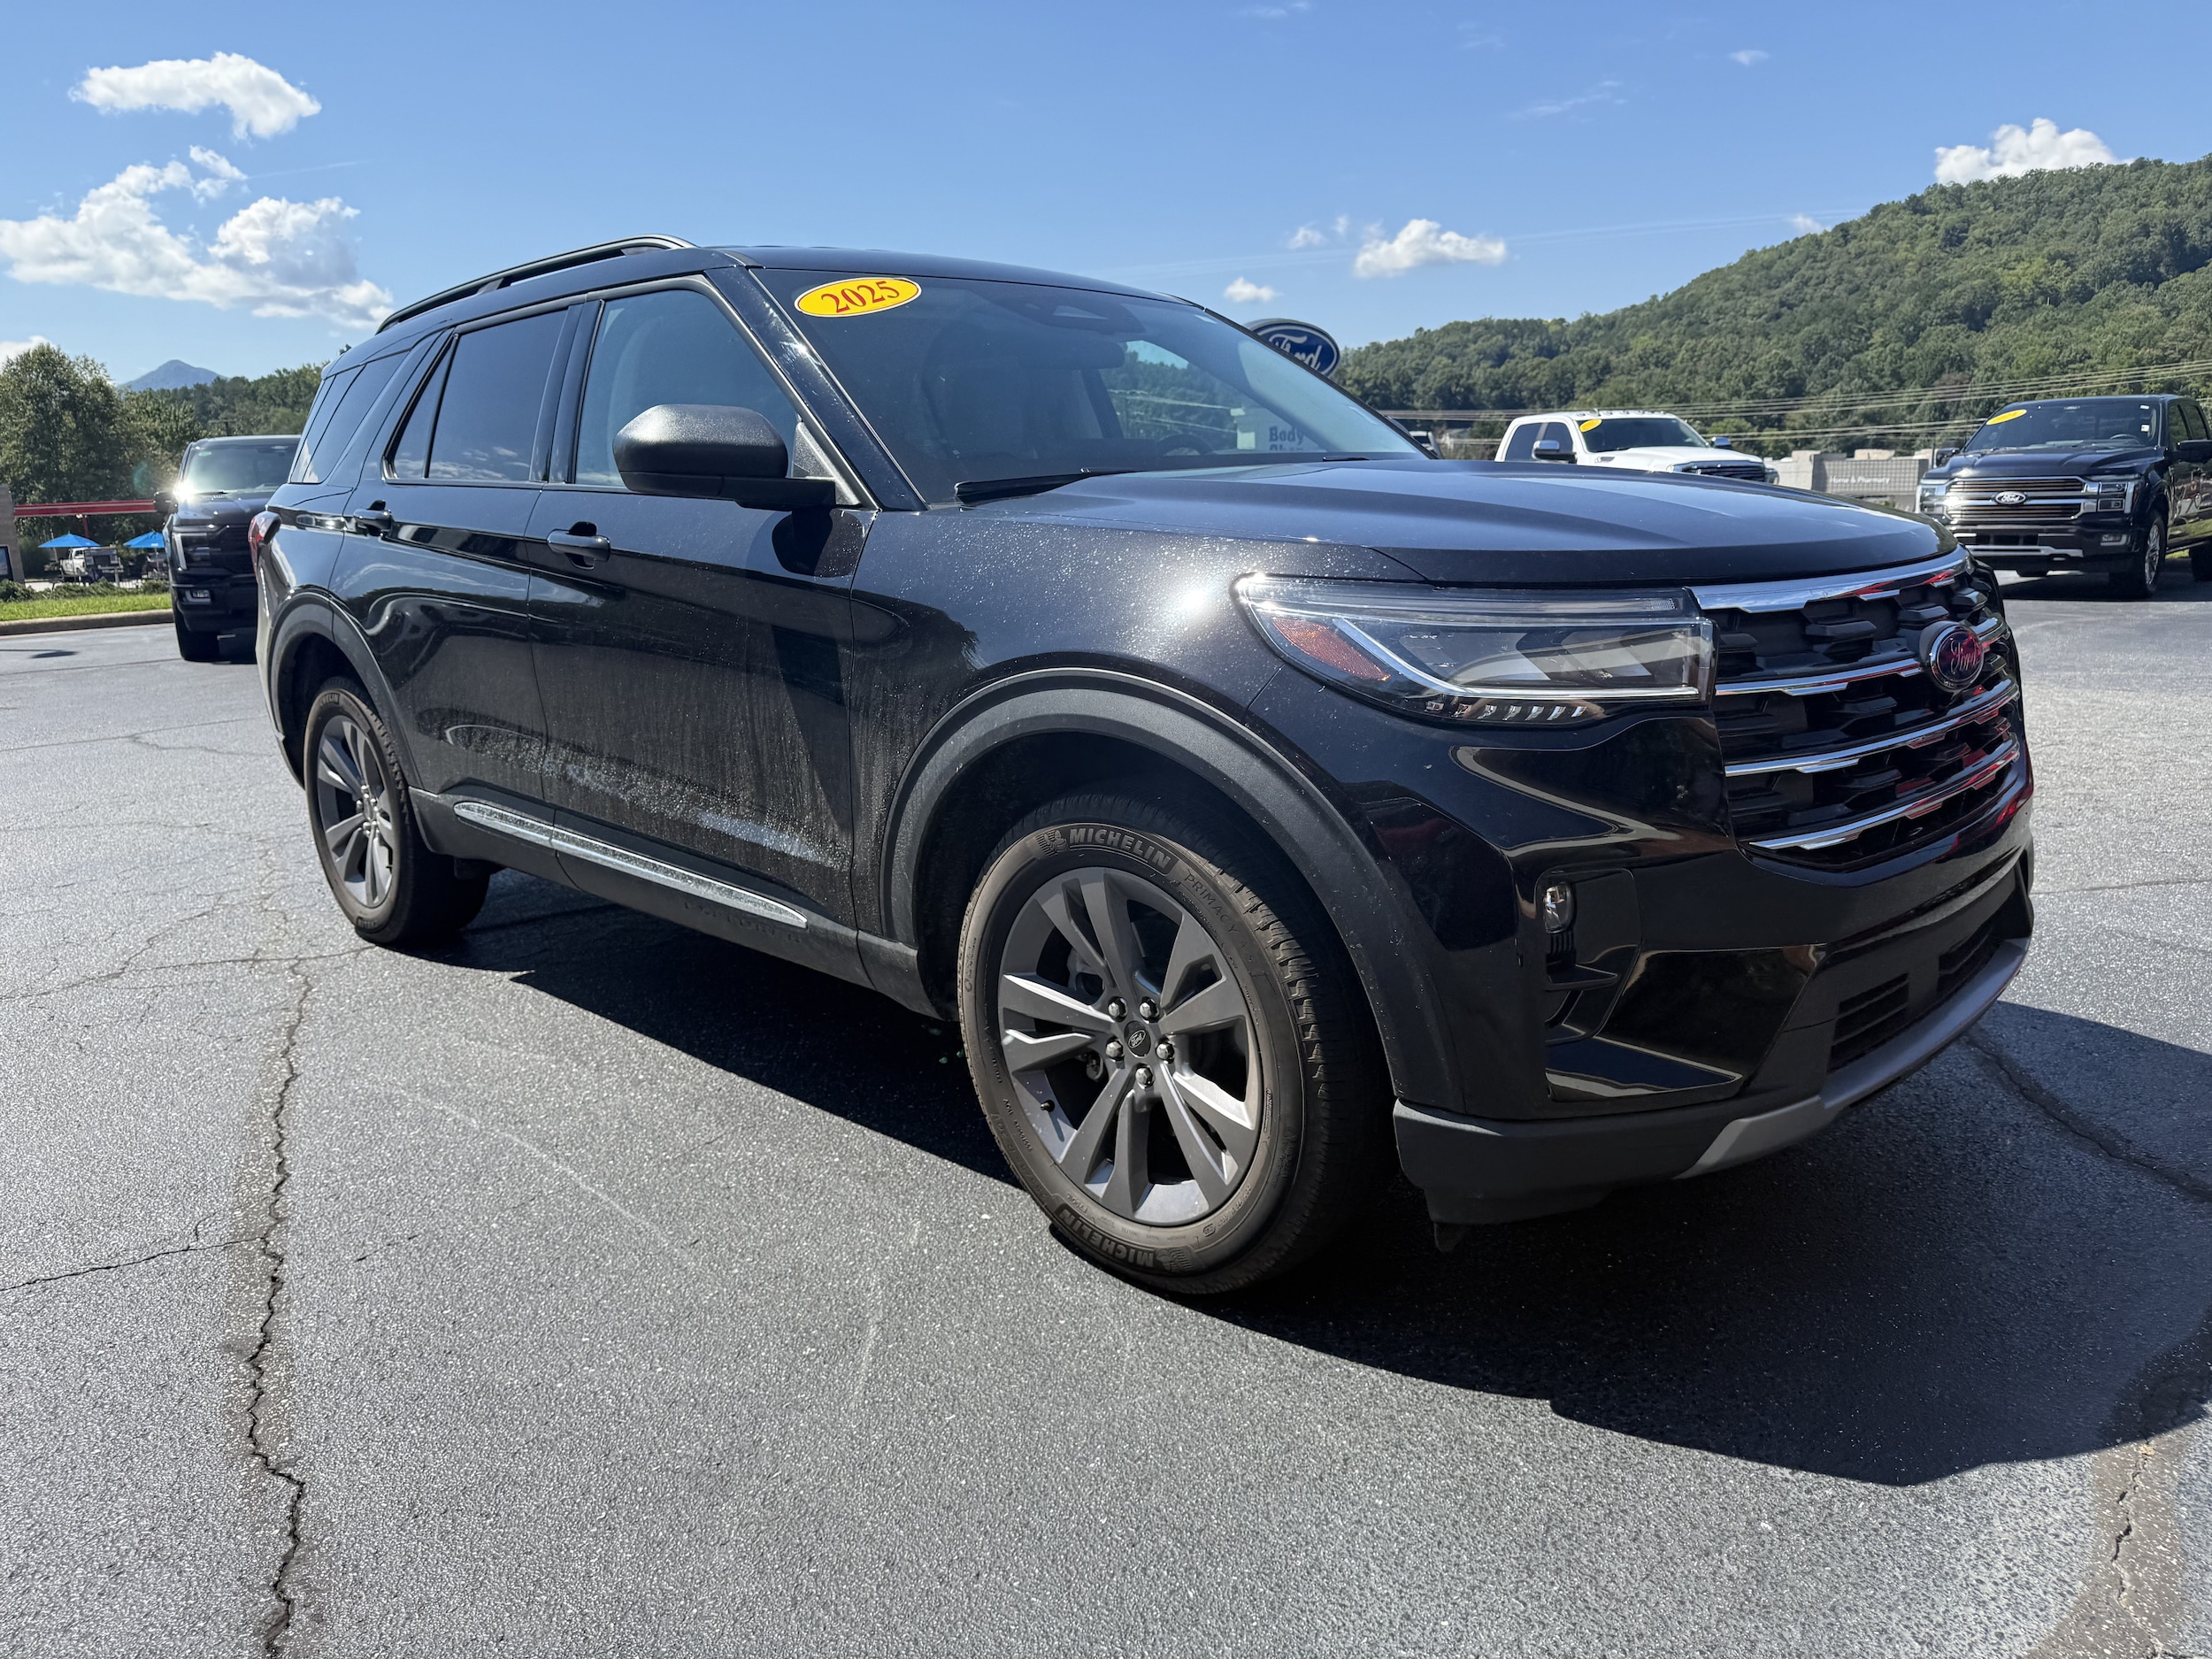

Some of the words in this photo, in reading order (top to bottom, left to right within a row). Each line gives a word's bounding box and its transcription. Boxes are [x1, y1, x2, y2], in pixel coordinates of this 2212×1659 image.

[821, 280, 900, 313] 2025
[1268, 334, 1322, 371] Fd
[1269, 426, 1303, 446] Body
[1950, 640, 1980, 675] Ford
[1069, 828, 1172, 870] MICHELIN
[1184, 868, 1240, 934] PRIMACY
[1059, 1209, 1156, 1268] MICHELIN
